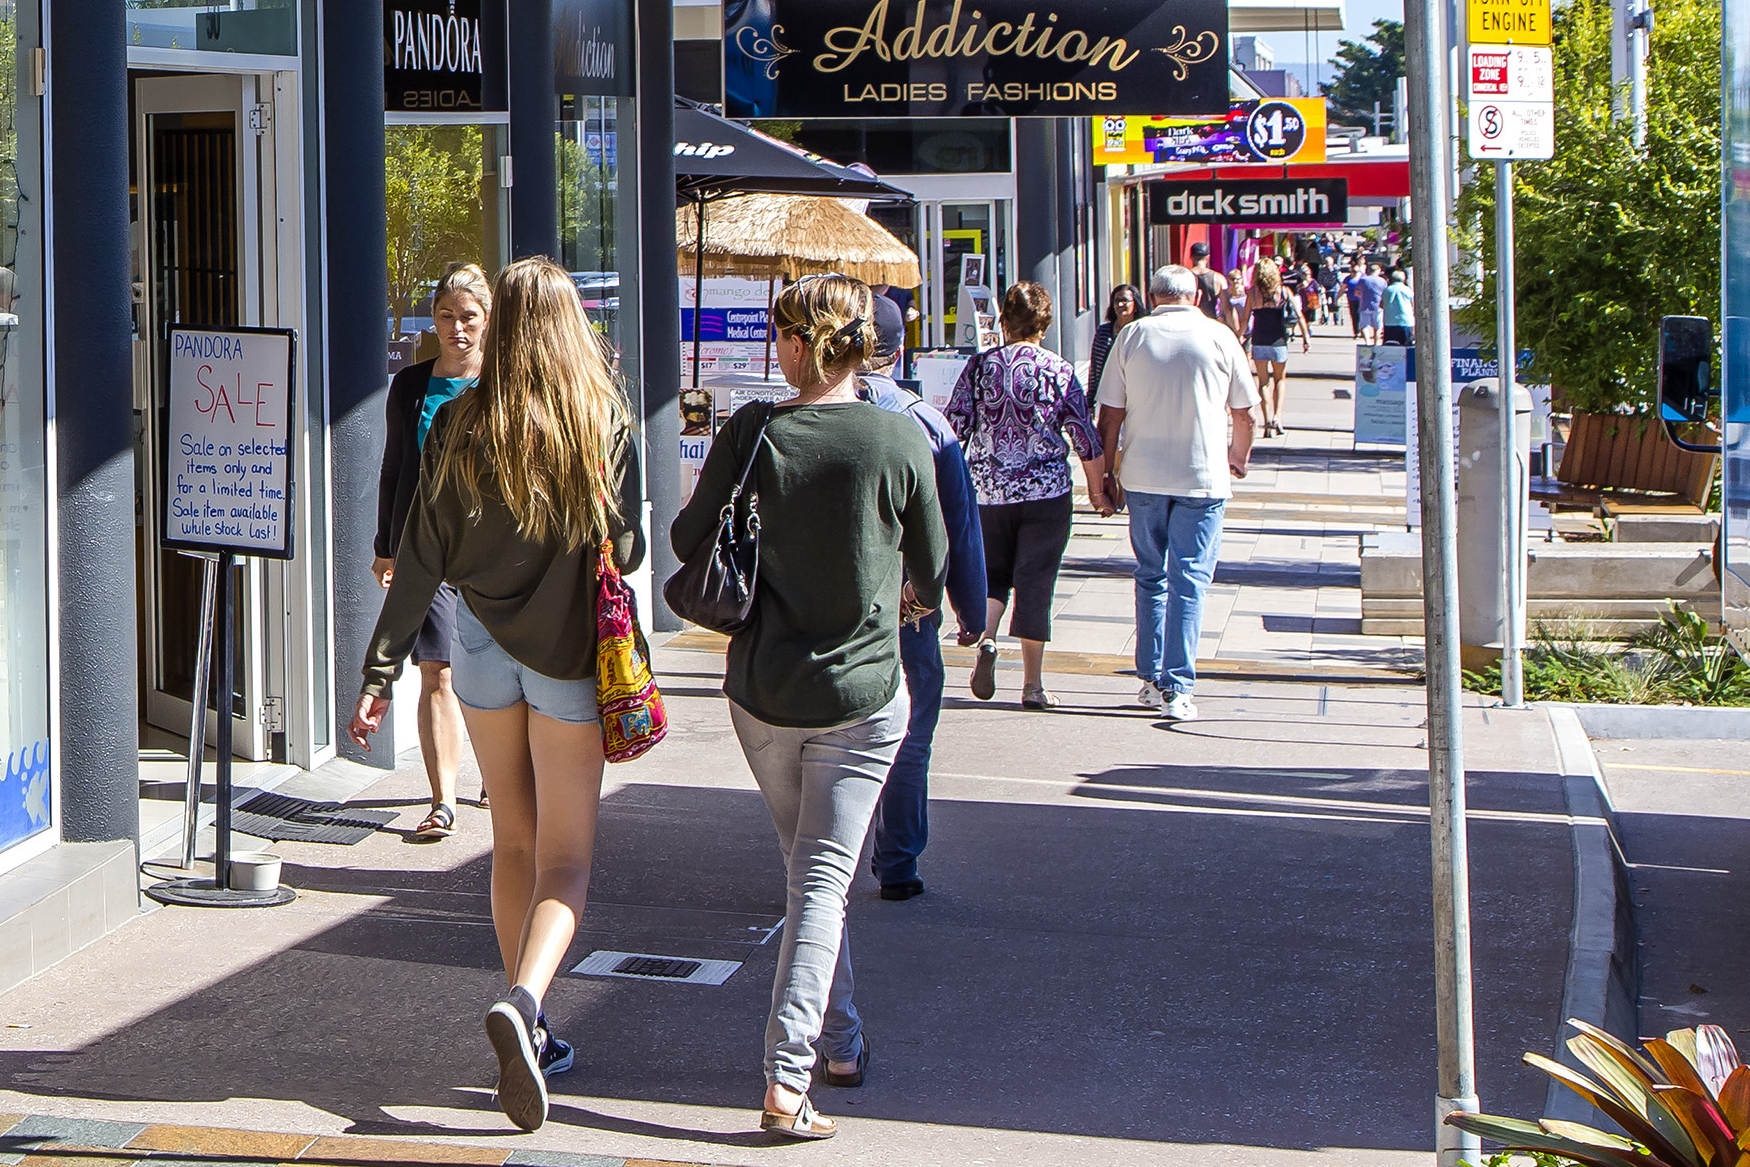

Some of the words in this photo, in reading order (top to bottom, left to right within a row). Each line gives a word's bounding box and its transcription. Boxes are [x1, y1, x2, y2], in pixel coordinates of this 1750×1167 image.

[1483, 12, 1536, 32] ENGINE
[394, 10, 482, 74] PANDORA
[1474, 55, 1507, 68] LOADING
[1479, 68, 1501, 81] ZONE
[844, 84, 947, 102] LADIES
[967, 82, 1117, 102] FASHIONS
[1167, 189, 1235, 216] dick
[1239, 187, 1328, 215] smith
[709, 287, 751, 301] mango
[727, 310, 759, 325] Centrepoint
[727, 326, 749, 338] Medical
[750, 327, 768, 338] Centre
[175, 334, 243, 361] PANDORA
[1461, 368, 1498, 377] PLANN
[194, 364, 275, 427] SALE
[180, 433, 214, 456] Sale
[218, 445, 232, 456] on
[238, 437, 287, 456] selected
[680, 440, 704, 459] hai
[187, 459, 217, 474] items
[224, 460, 247, 481] only
[251, 461, 272, 475] and
[177, 474, 193, 494] for
[199, 485, 207, 494] a
[213, 482, 252, 498] limited
[259, 482, 286, 500] time.
[172, 497, 199, 518] Sale
[203, 501, 224, 518] item
[230, 503, 278, 522] available
